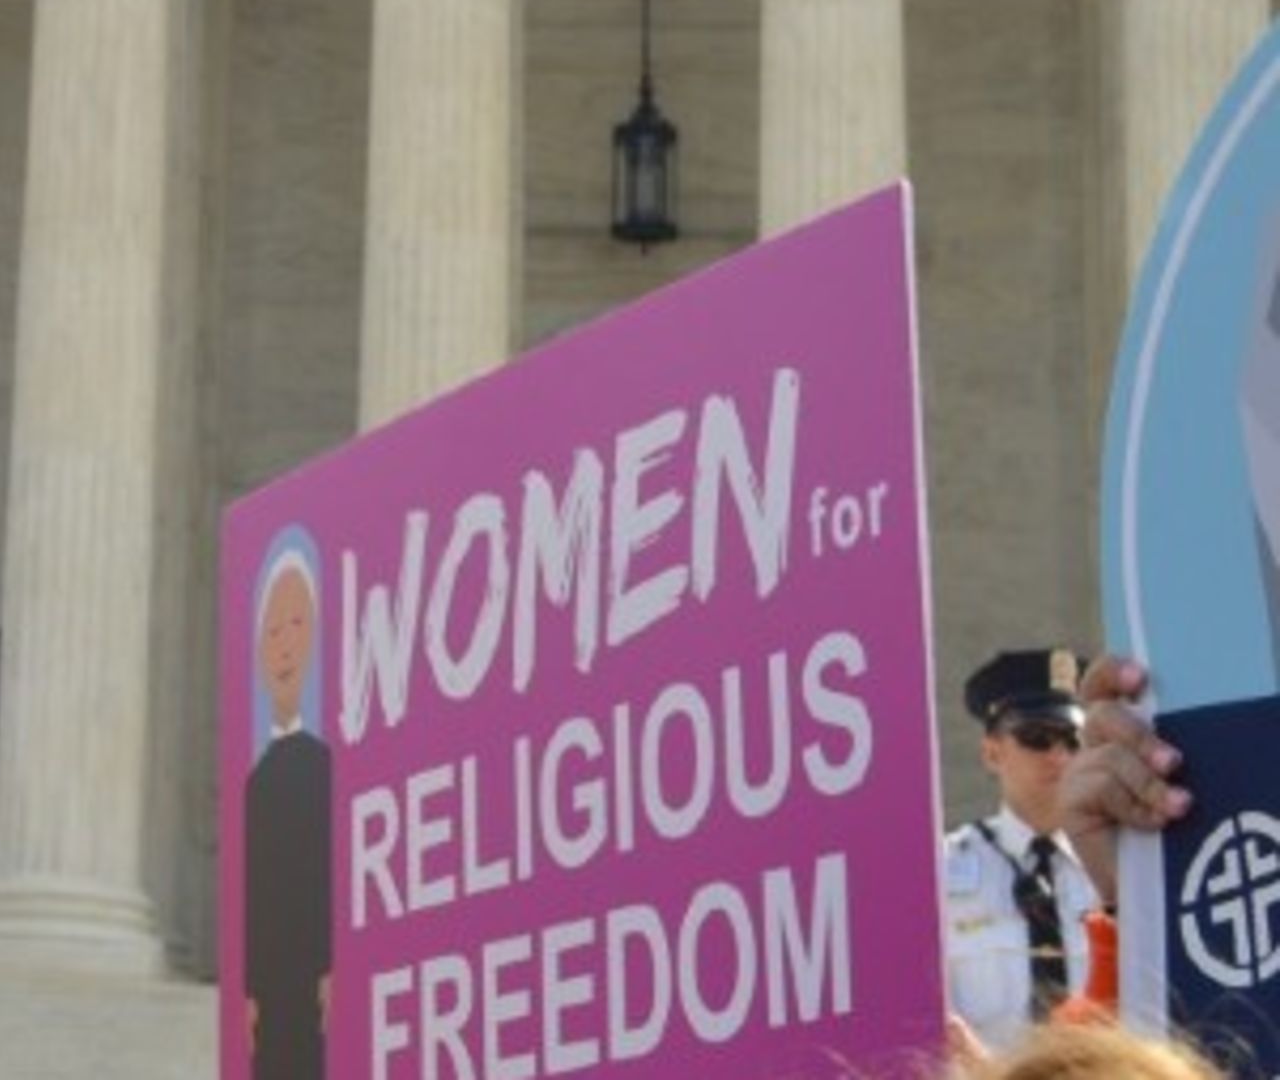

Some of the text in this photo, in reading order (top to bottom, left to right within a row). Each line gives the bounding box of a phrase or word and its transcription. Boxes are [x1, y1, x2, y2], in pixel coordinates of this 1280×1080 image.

[338, 367, 889, 745] WOMEN for
[350, 631, 873, 928] RELIGIOUS
[371, 852, 851, 1080] FREEDOM
